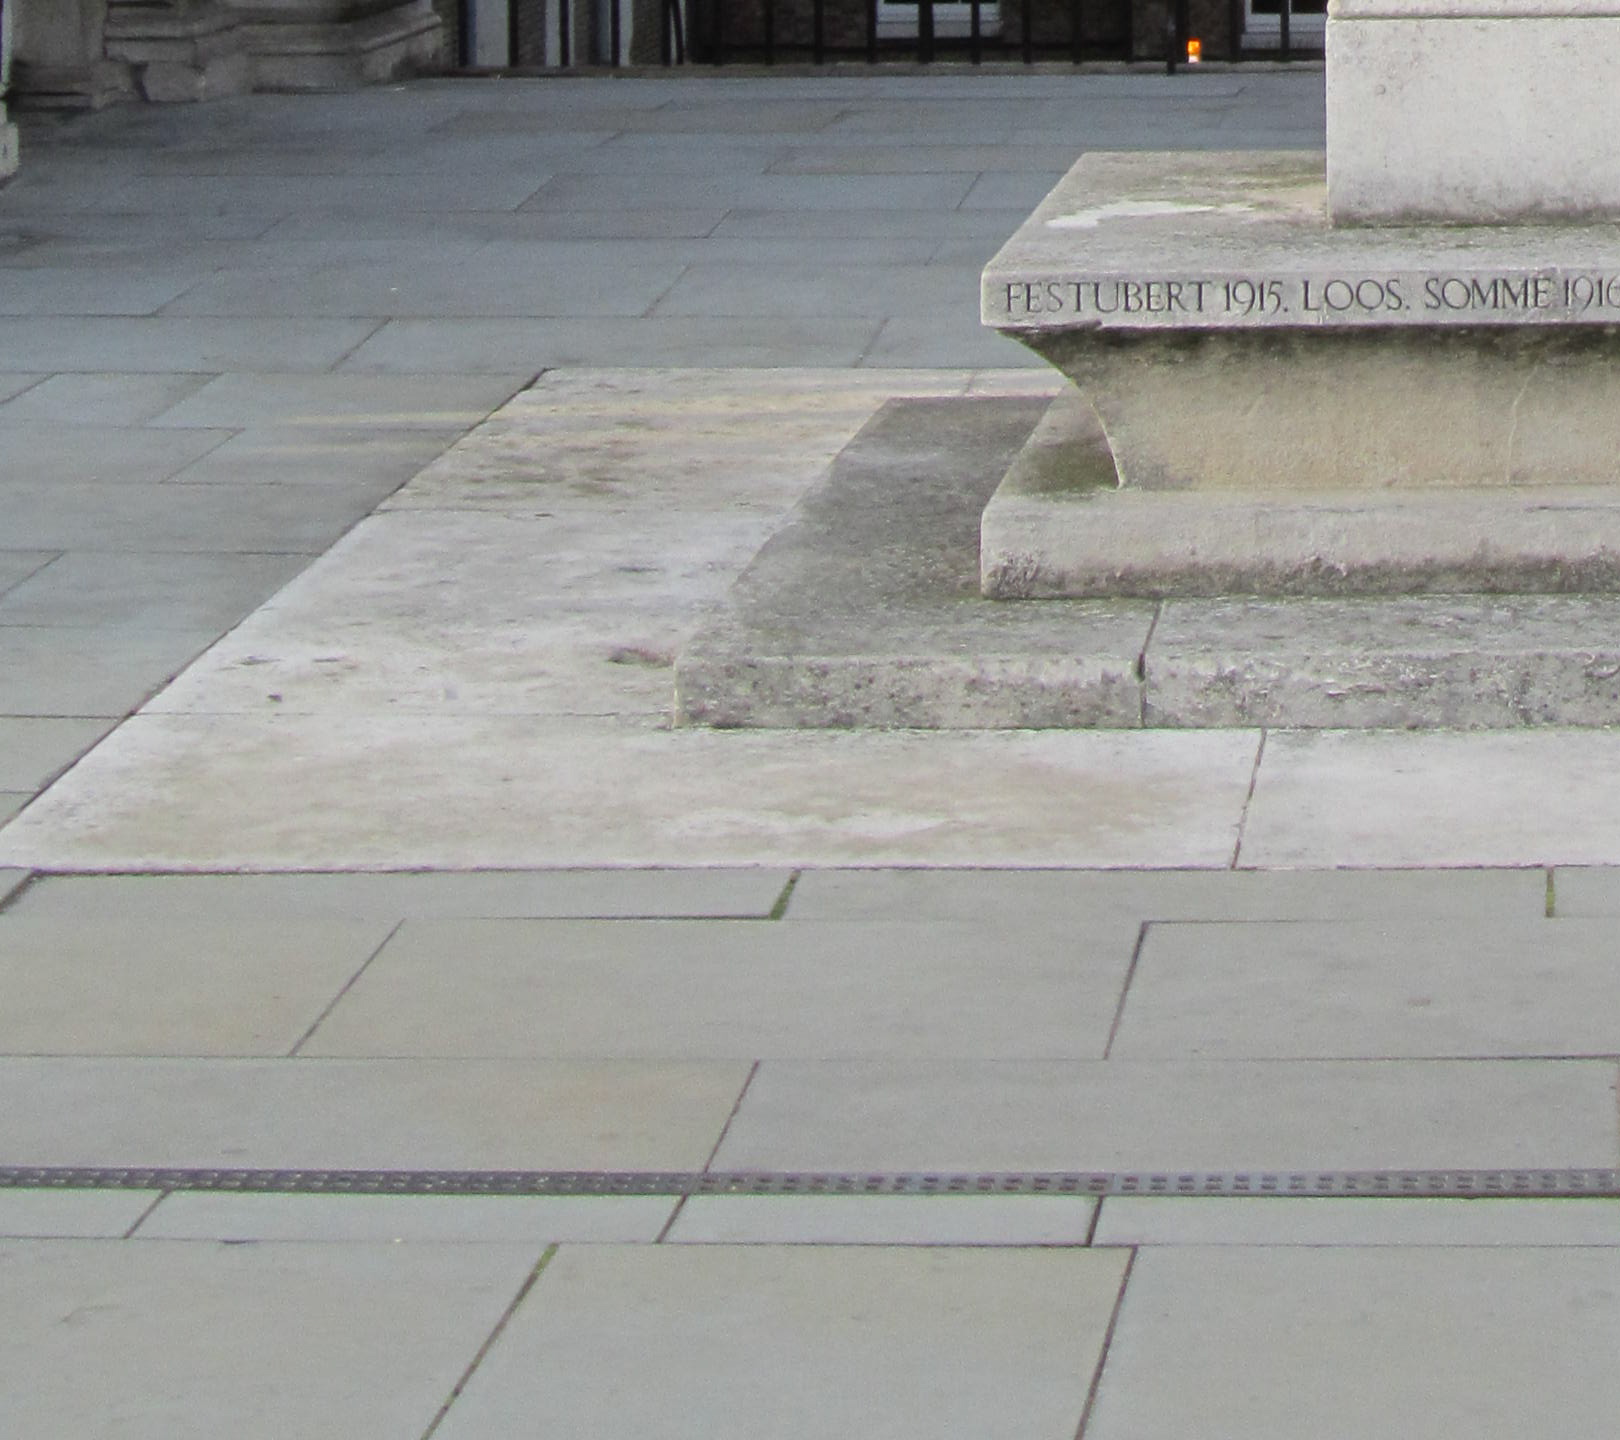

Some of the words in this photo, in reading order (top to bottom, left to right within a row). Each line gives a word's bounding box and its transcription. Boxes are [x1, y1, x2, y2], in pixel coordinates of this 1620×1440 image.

[1006, 280, 1212, 313] FESTUBERT
[1224, 280, 1289, 317] 1915.
[1302, 279, 1410, 311] LOOS.
[1425, 277, 1552, 310] SOMME
